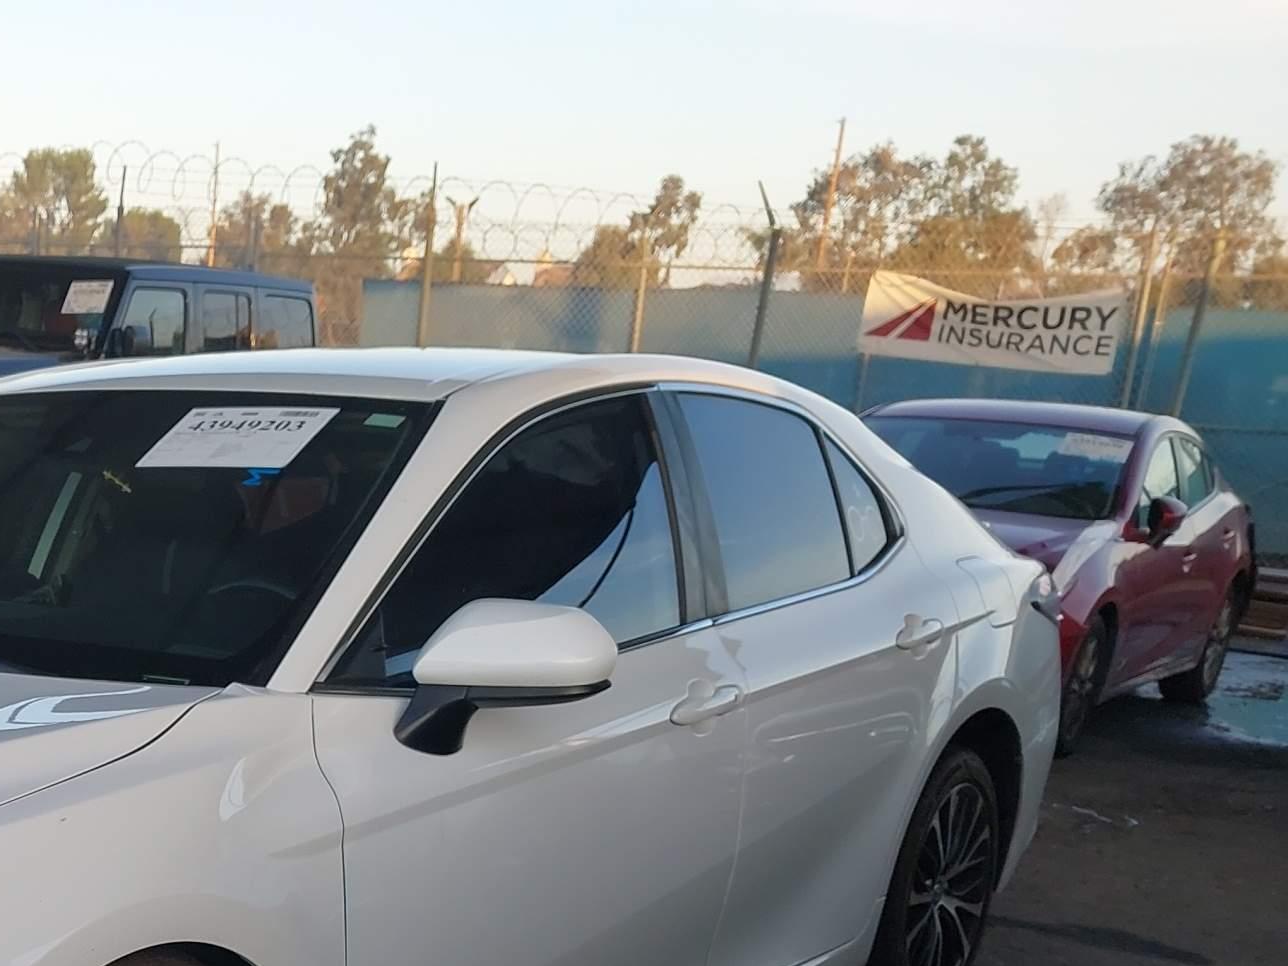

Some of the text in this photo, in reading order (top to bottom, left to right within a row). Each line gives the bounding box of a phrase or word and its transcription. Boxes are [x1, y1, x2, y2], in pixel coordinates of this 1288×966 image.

[942, 300, 1120, 331] MERCURY
[937, 324, 1115, 356] INSURANCE
[188, 419, 306, 433] 43949203
